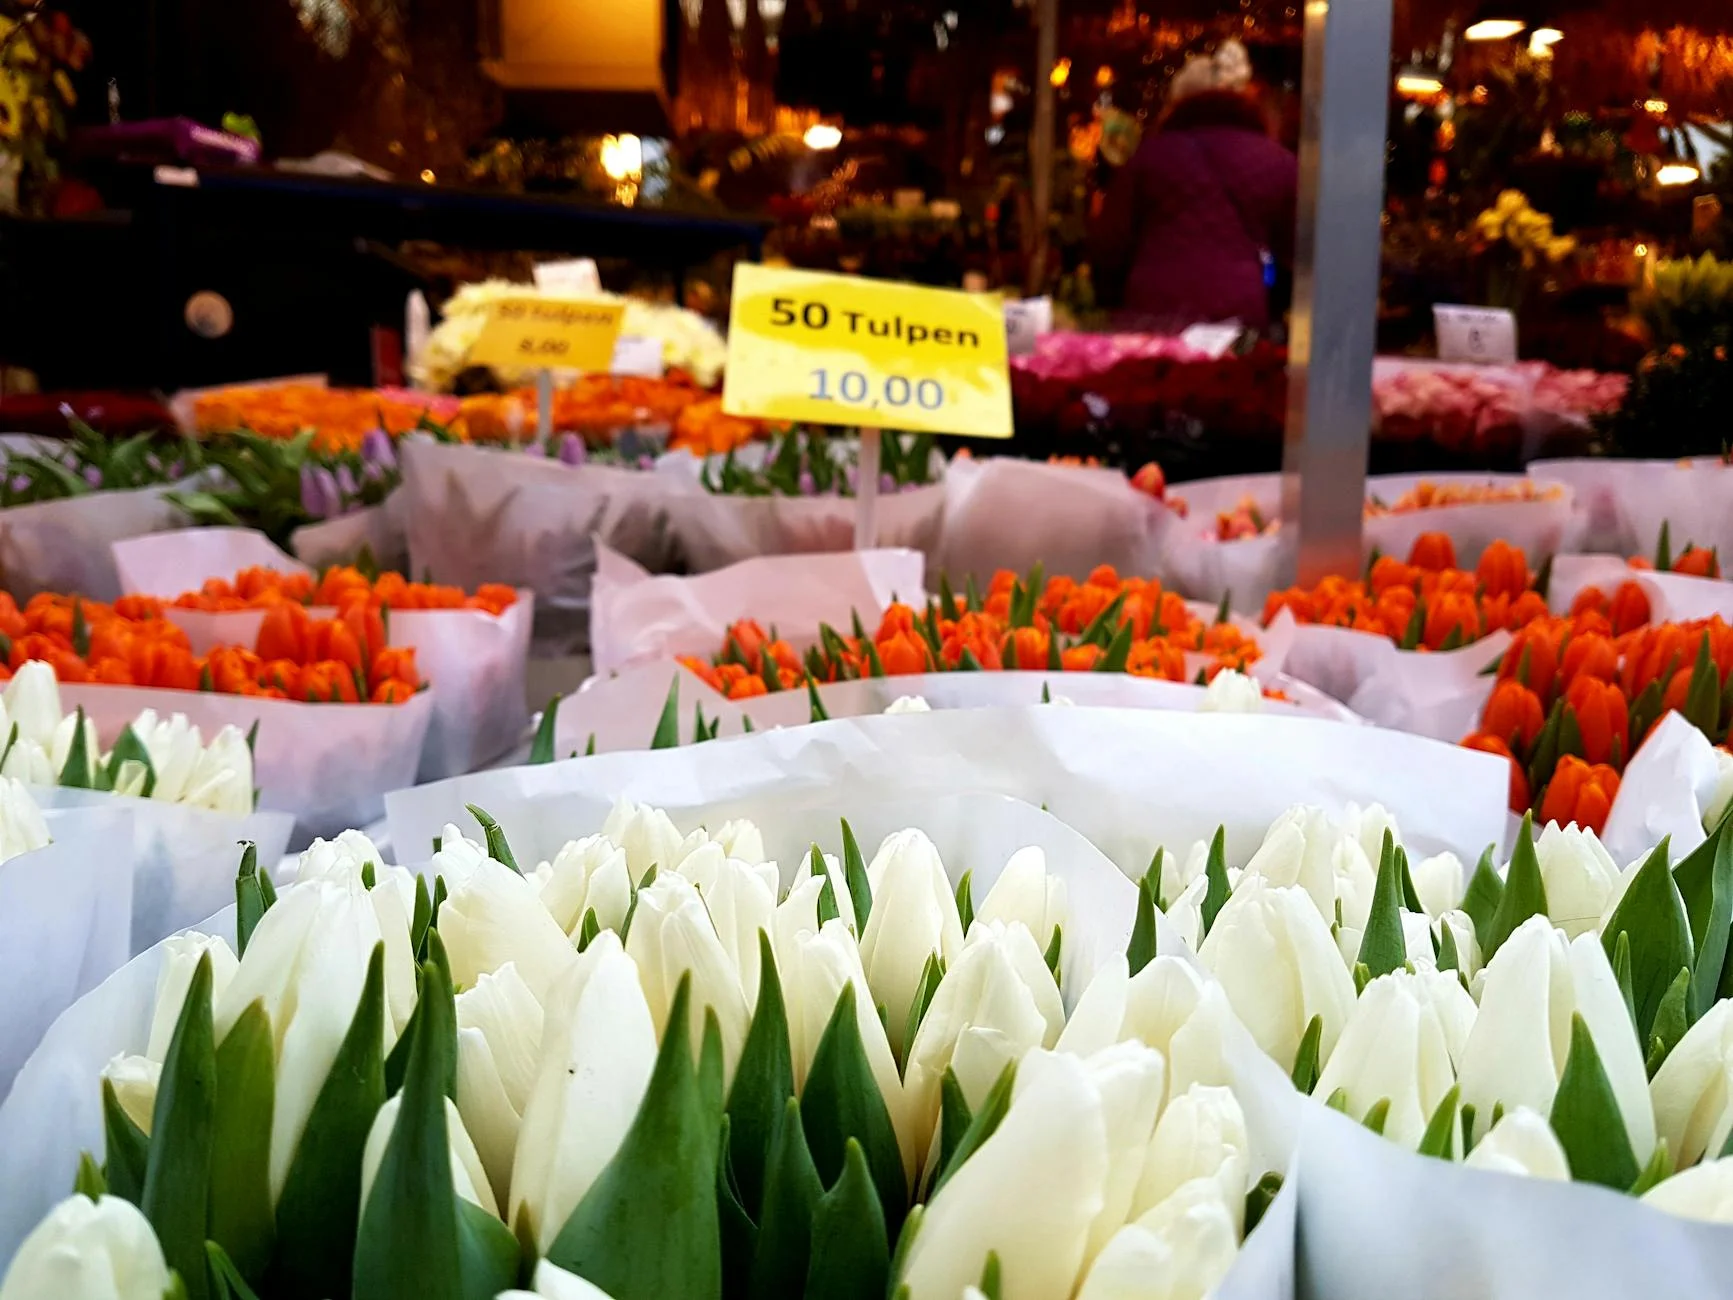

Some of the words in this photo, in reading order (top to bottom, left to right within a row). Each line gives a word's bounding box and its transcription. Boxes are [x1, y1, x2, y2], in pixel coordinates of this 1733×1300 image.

[770, 297, 830, 331] 50
[842, 311, 980, 348] Tulpen
[808, 368, 945, 412] 10,00
